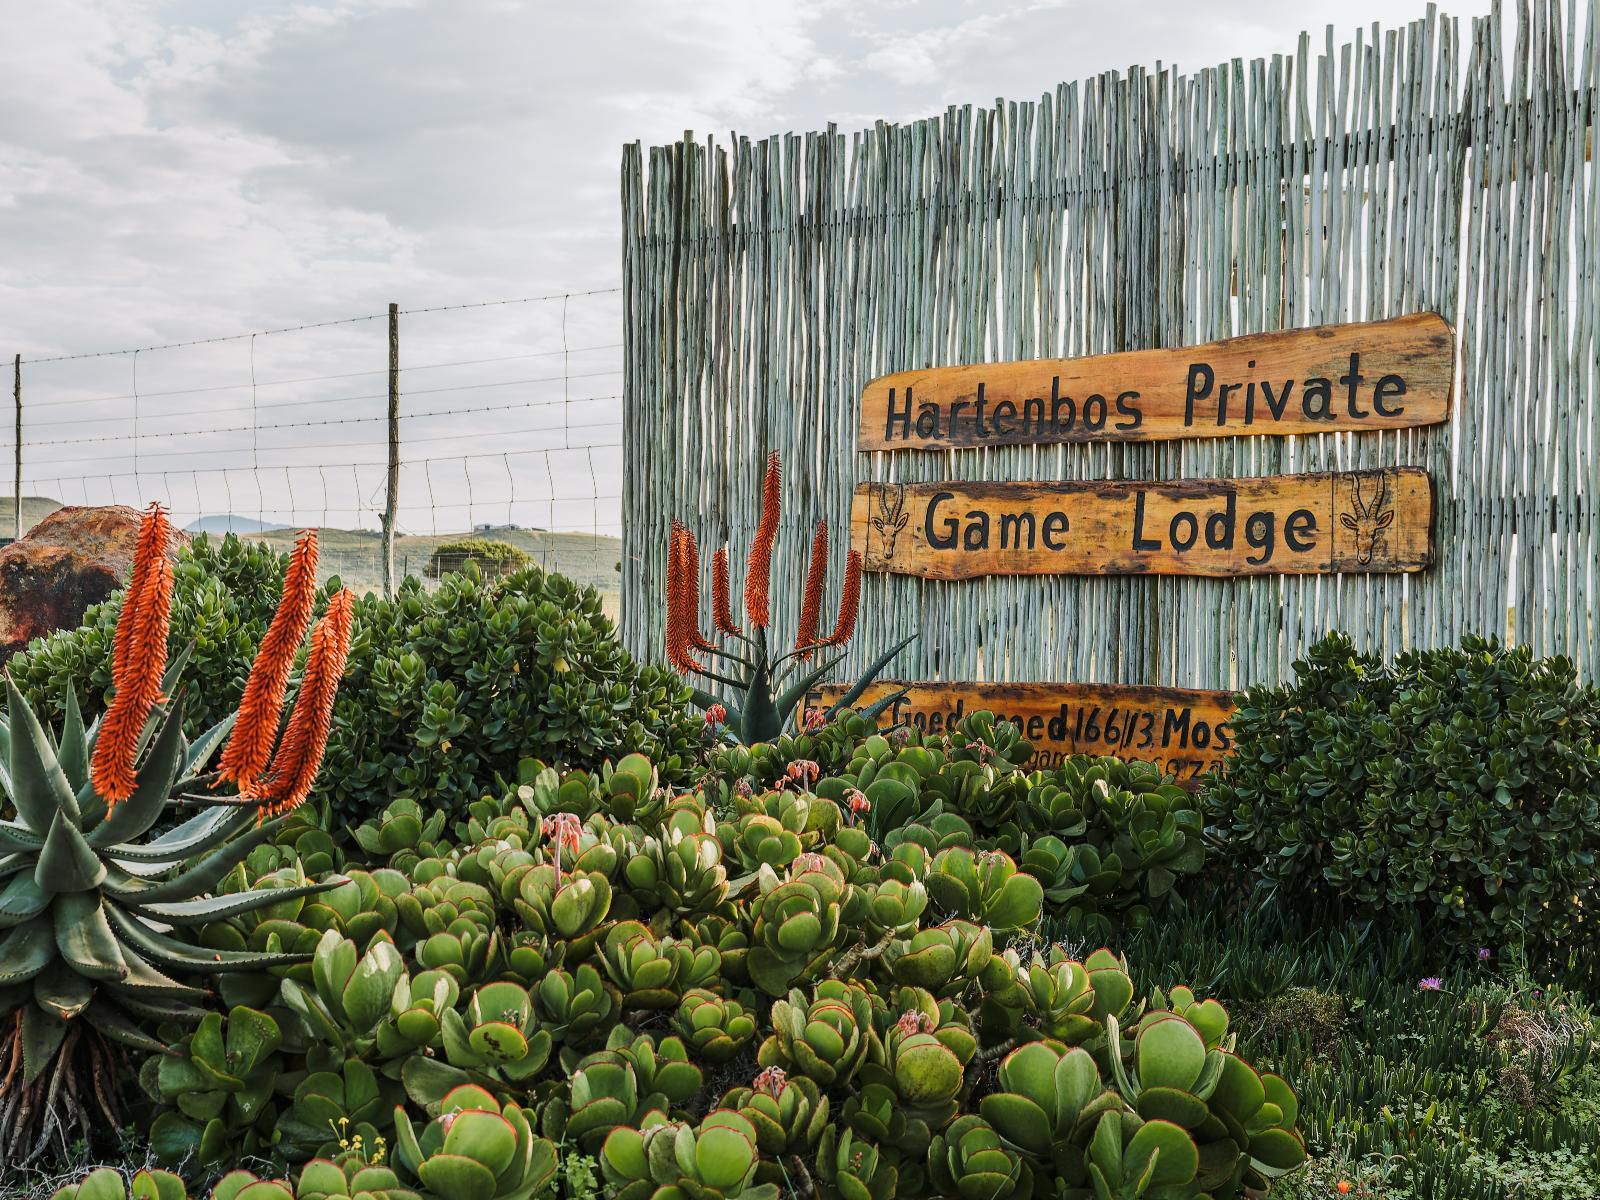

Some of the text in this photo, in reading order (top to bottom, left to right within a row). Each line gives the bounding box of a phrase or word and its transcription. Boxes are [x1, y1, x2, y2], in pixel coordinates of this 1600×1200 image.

[884, 352, 1407, 442] Hartenbos Private
[924, 491, 1317, 565] Game Lodge
